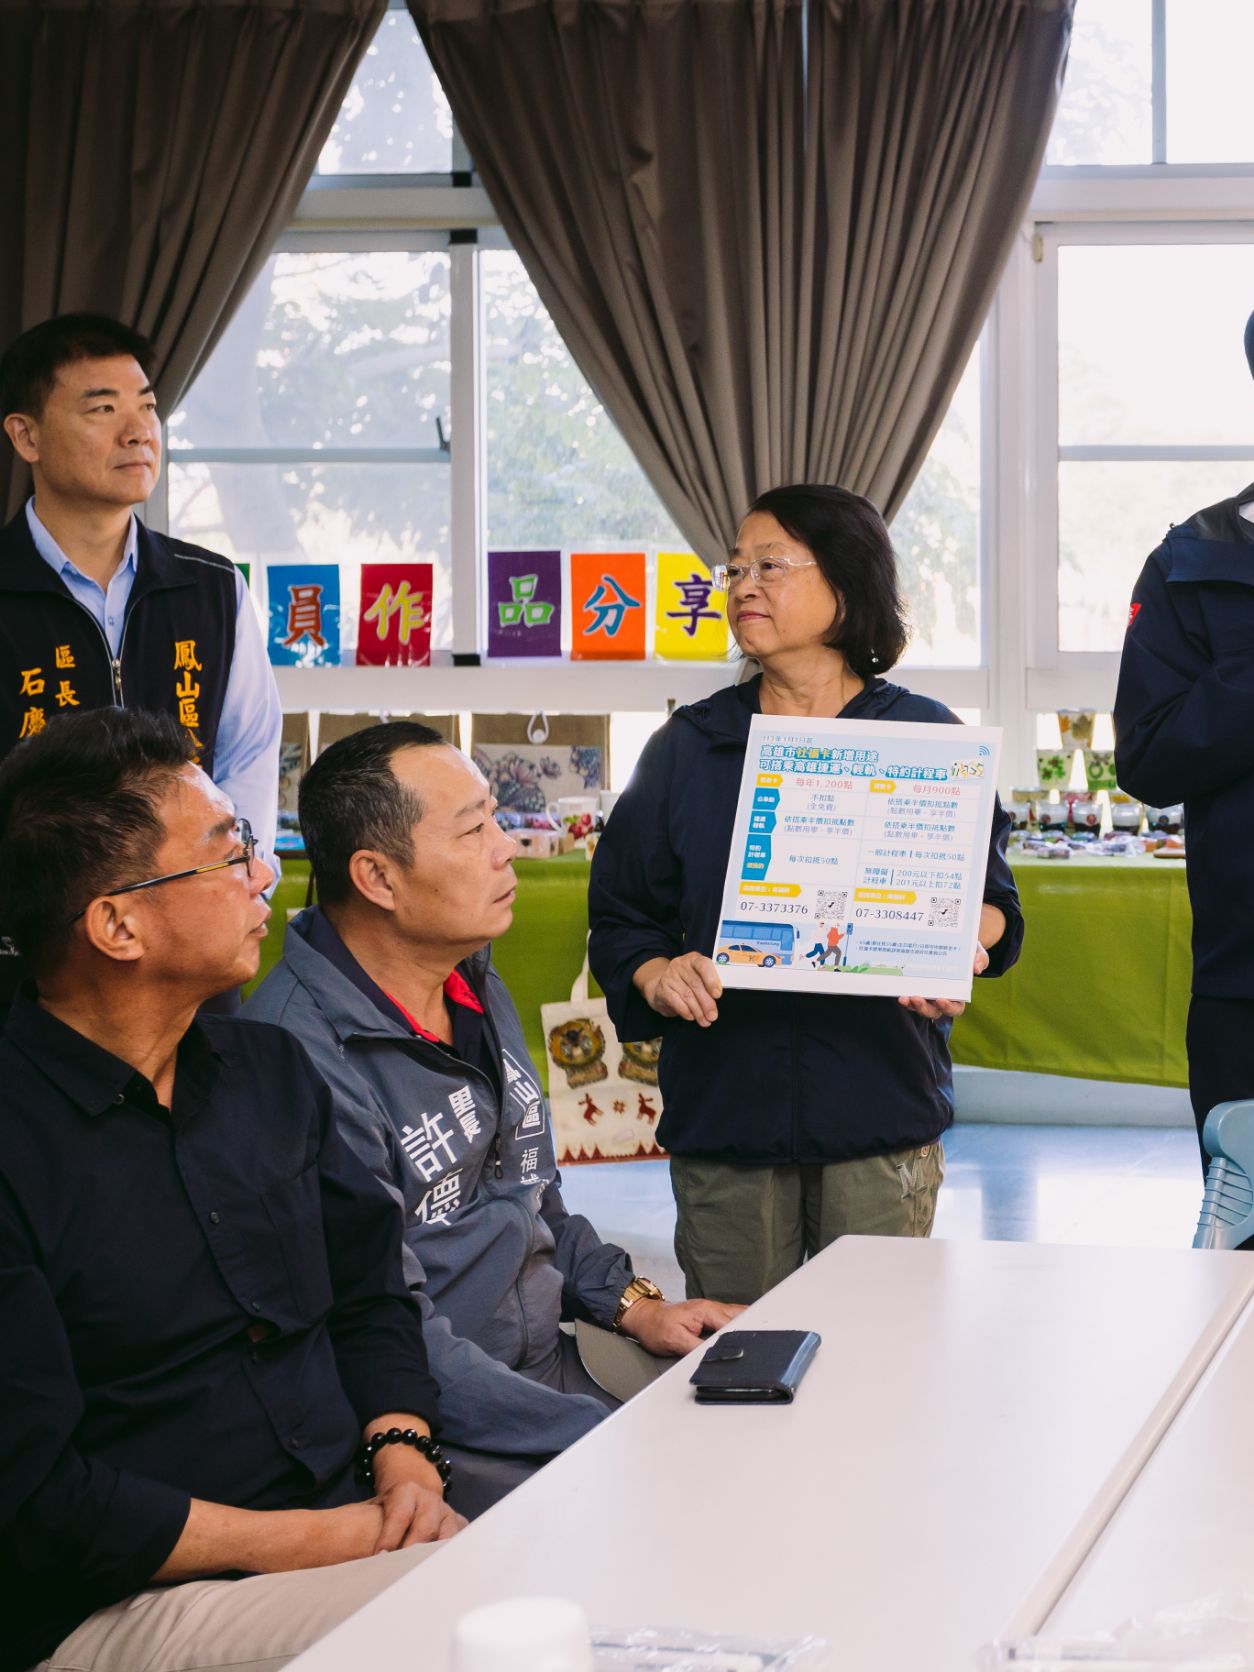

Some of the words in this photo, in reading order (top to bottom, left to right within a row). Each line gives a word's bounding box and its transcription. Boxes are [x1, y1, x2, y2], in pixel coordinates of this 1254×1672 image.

[55, 644, 80, 707] 區長
[174, 639, 203, 769] 鳳山區
[760, 744, 879, 762] 高雄市社福卡新增用途
[913, 784, 961, 796] 每月900點
[740, 901, 809, 915] 07-3373376
[855, 907, 924, 921] 07-3308447
